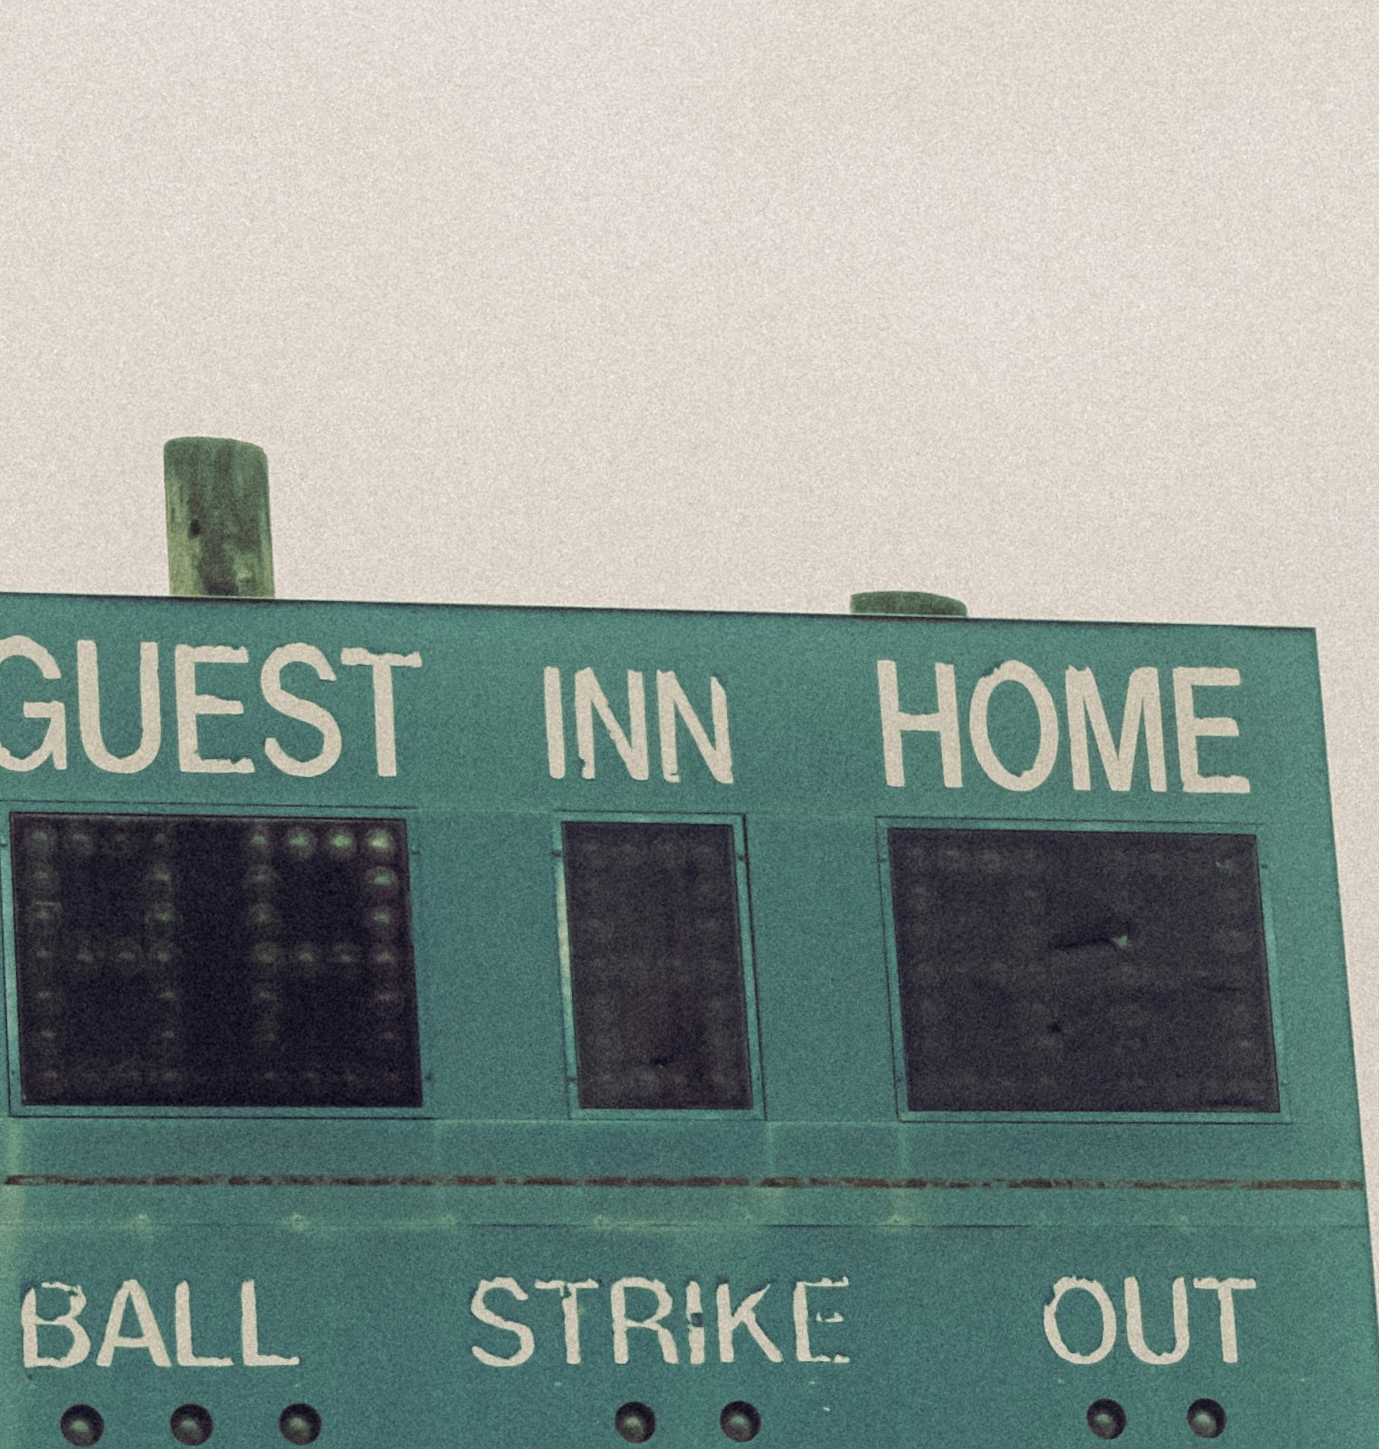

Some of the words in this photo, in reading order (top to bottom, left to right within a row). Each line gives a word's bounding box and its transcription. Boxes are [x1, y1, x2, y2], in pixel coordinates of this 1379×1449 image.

[543, 666, 734, 784] INN
[876, 659, 1251, 794] HOME
[21, 1278, 300, 1369] BALL
[470, 1276, 850, 1367] STRIKE
[1043, 1276, 1257, 1366] OUT
